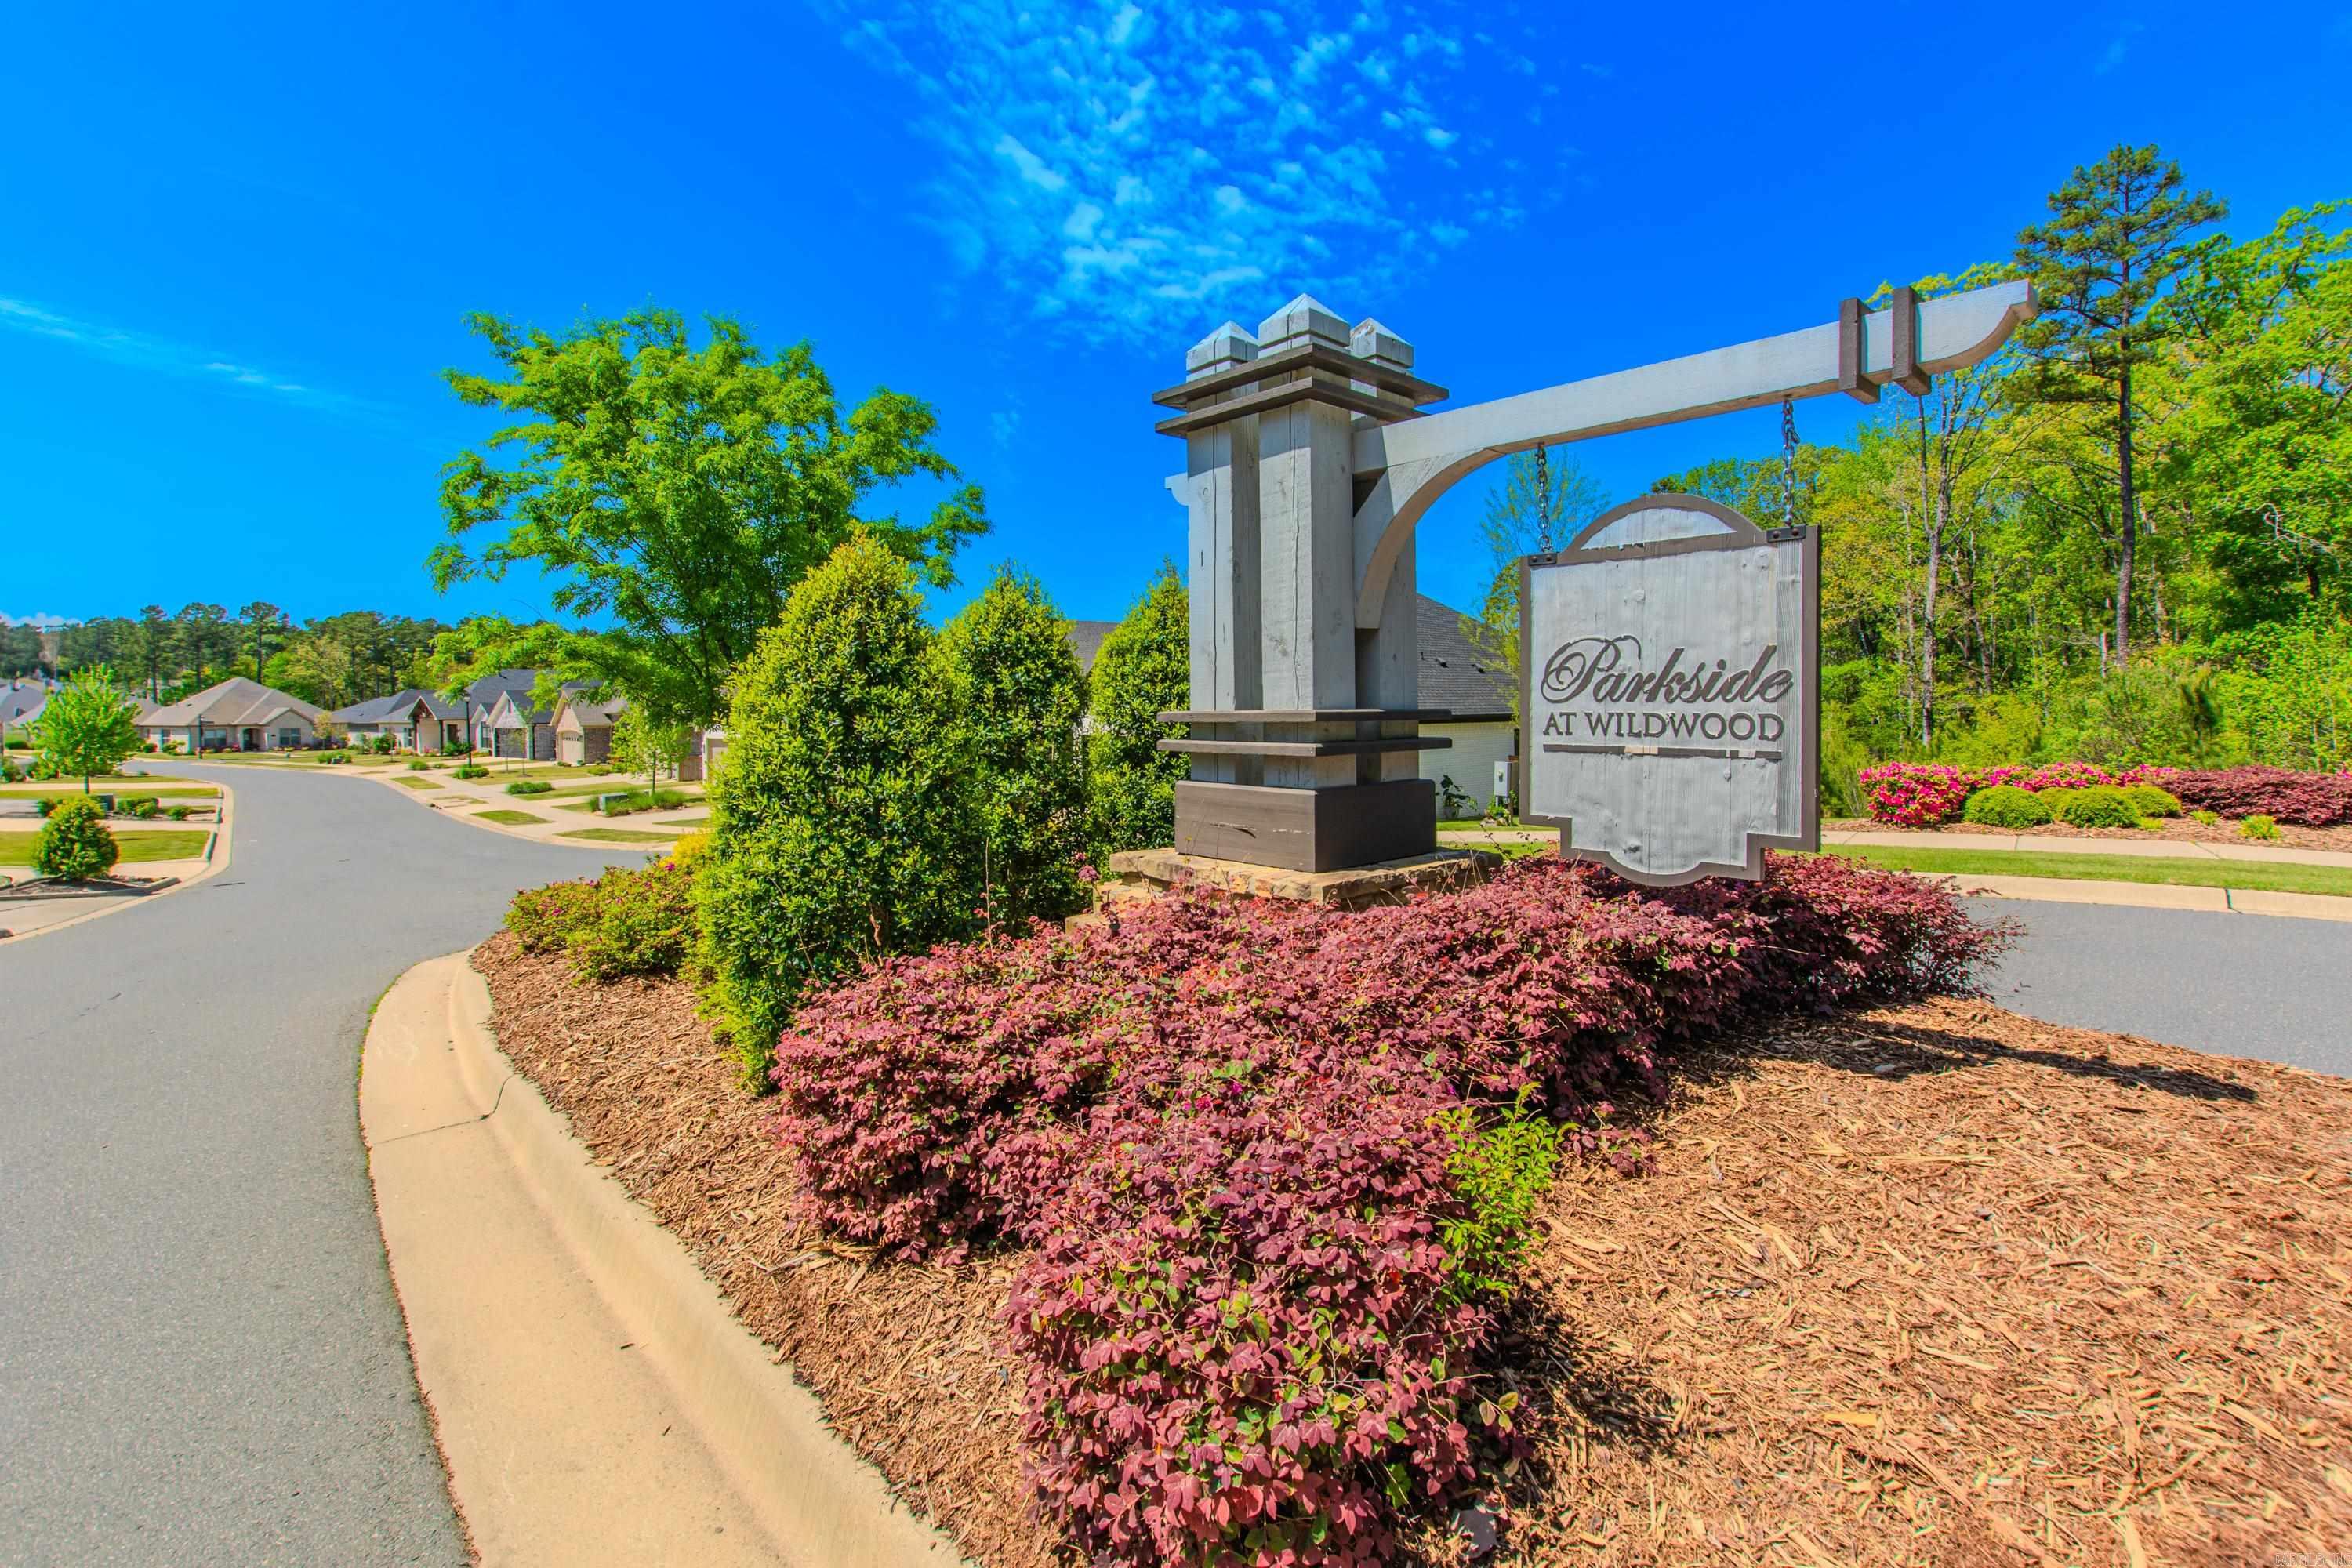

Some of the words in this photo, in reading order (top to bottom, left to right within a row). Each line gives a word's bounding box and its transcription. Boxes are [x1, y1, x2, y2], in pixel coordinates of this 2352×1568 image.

[1541, 635, 1793, 703] Parkside
[1542, 712, 1577, 736] AT
[1584, 712, 1784, 741] WILDWOOD
